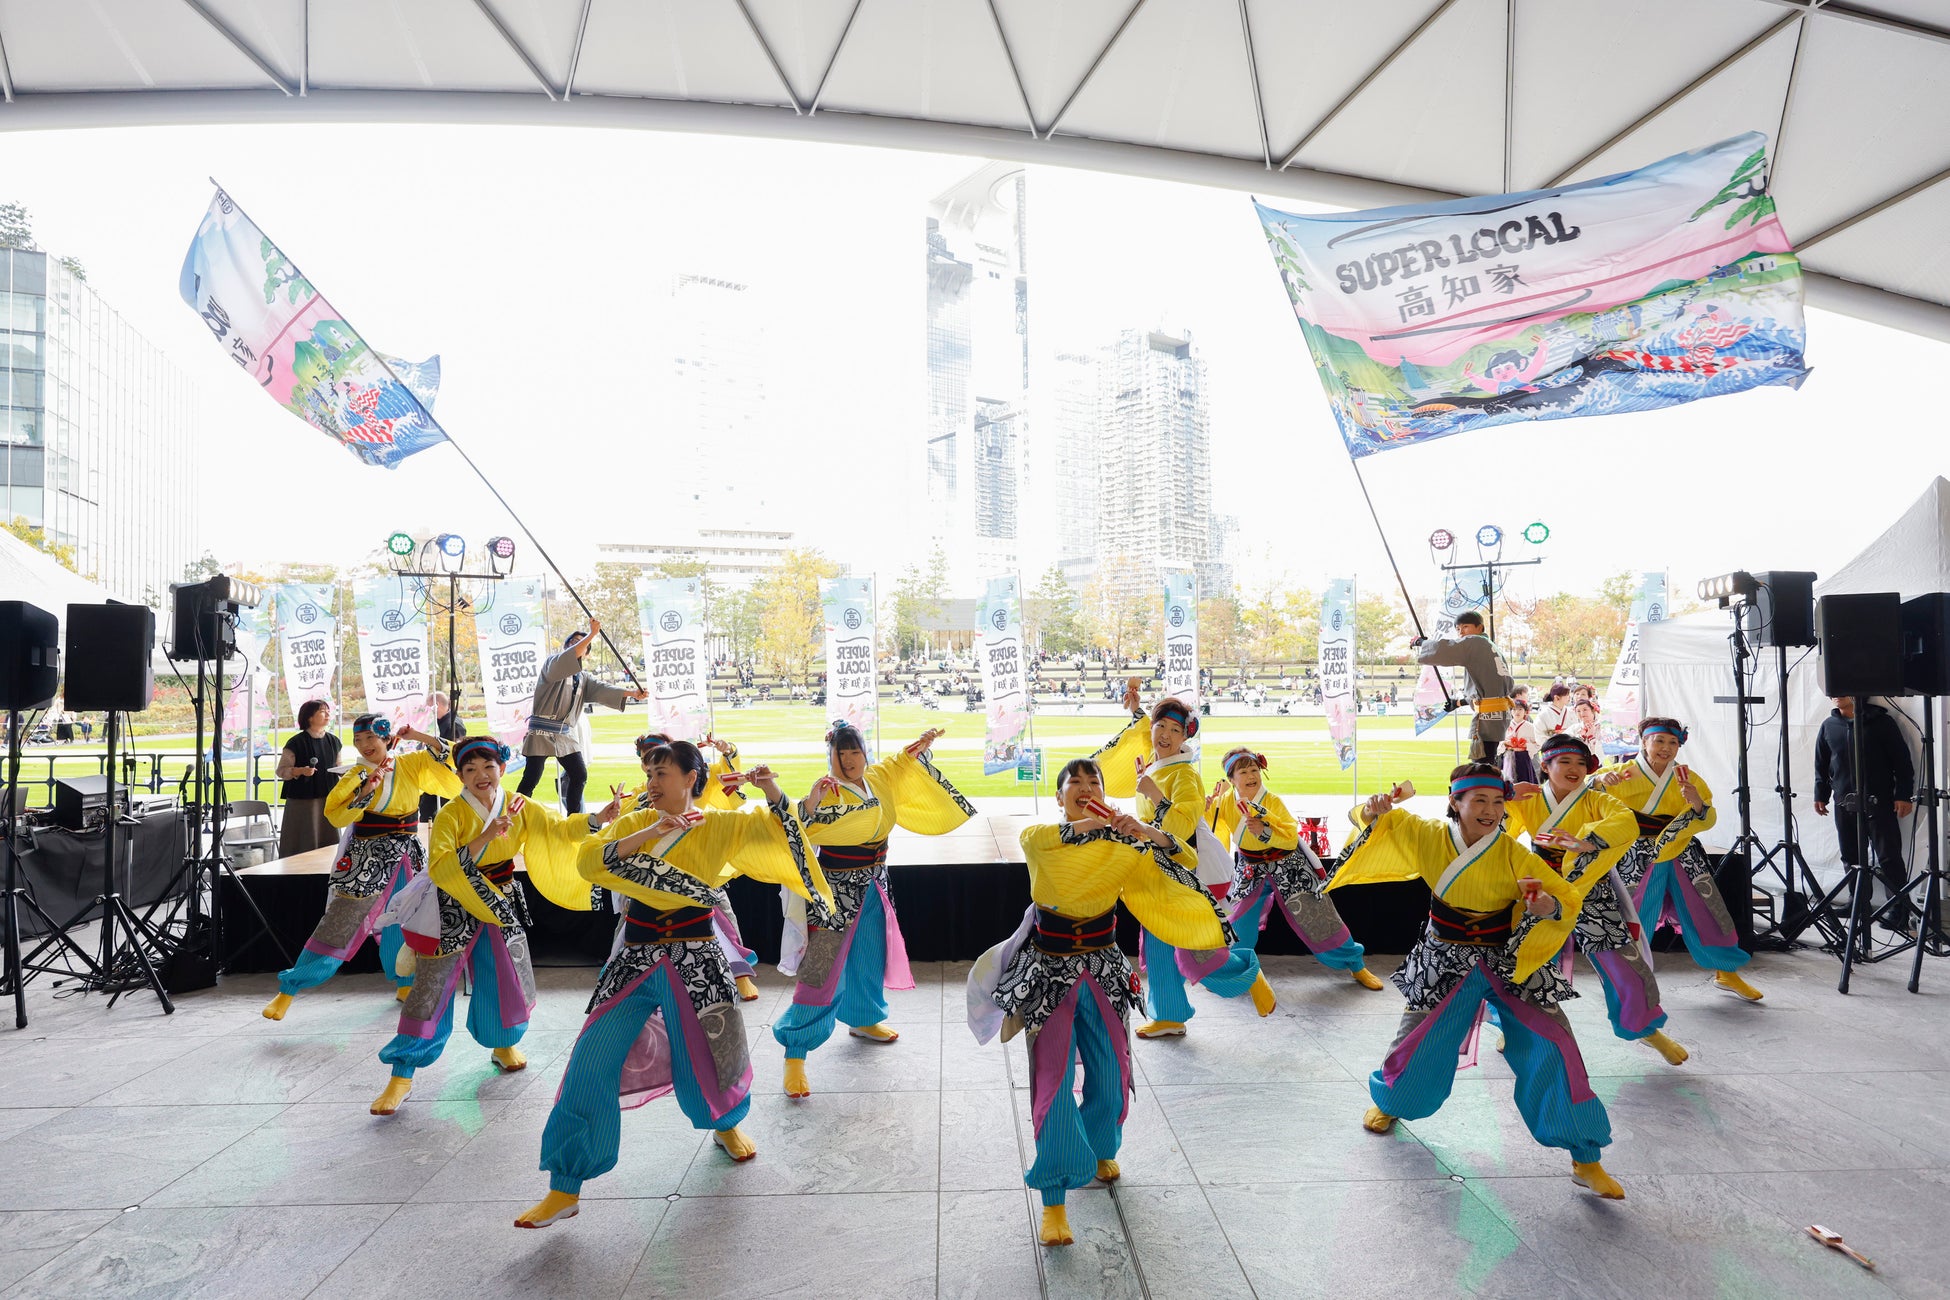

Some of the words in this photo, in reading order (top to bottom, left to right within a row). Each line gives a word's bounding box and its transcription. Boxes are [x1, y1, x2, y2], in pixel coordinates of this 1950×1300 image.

[1336, 240, 1450, 294] SUPER
[1449, 211, 1581, 264] LOCAL
[1395, 264, 1530, 323] 高知家
